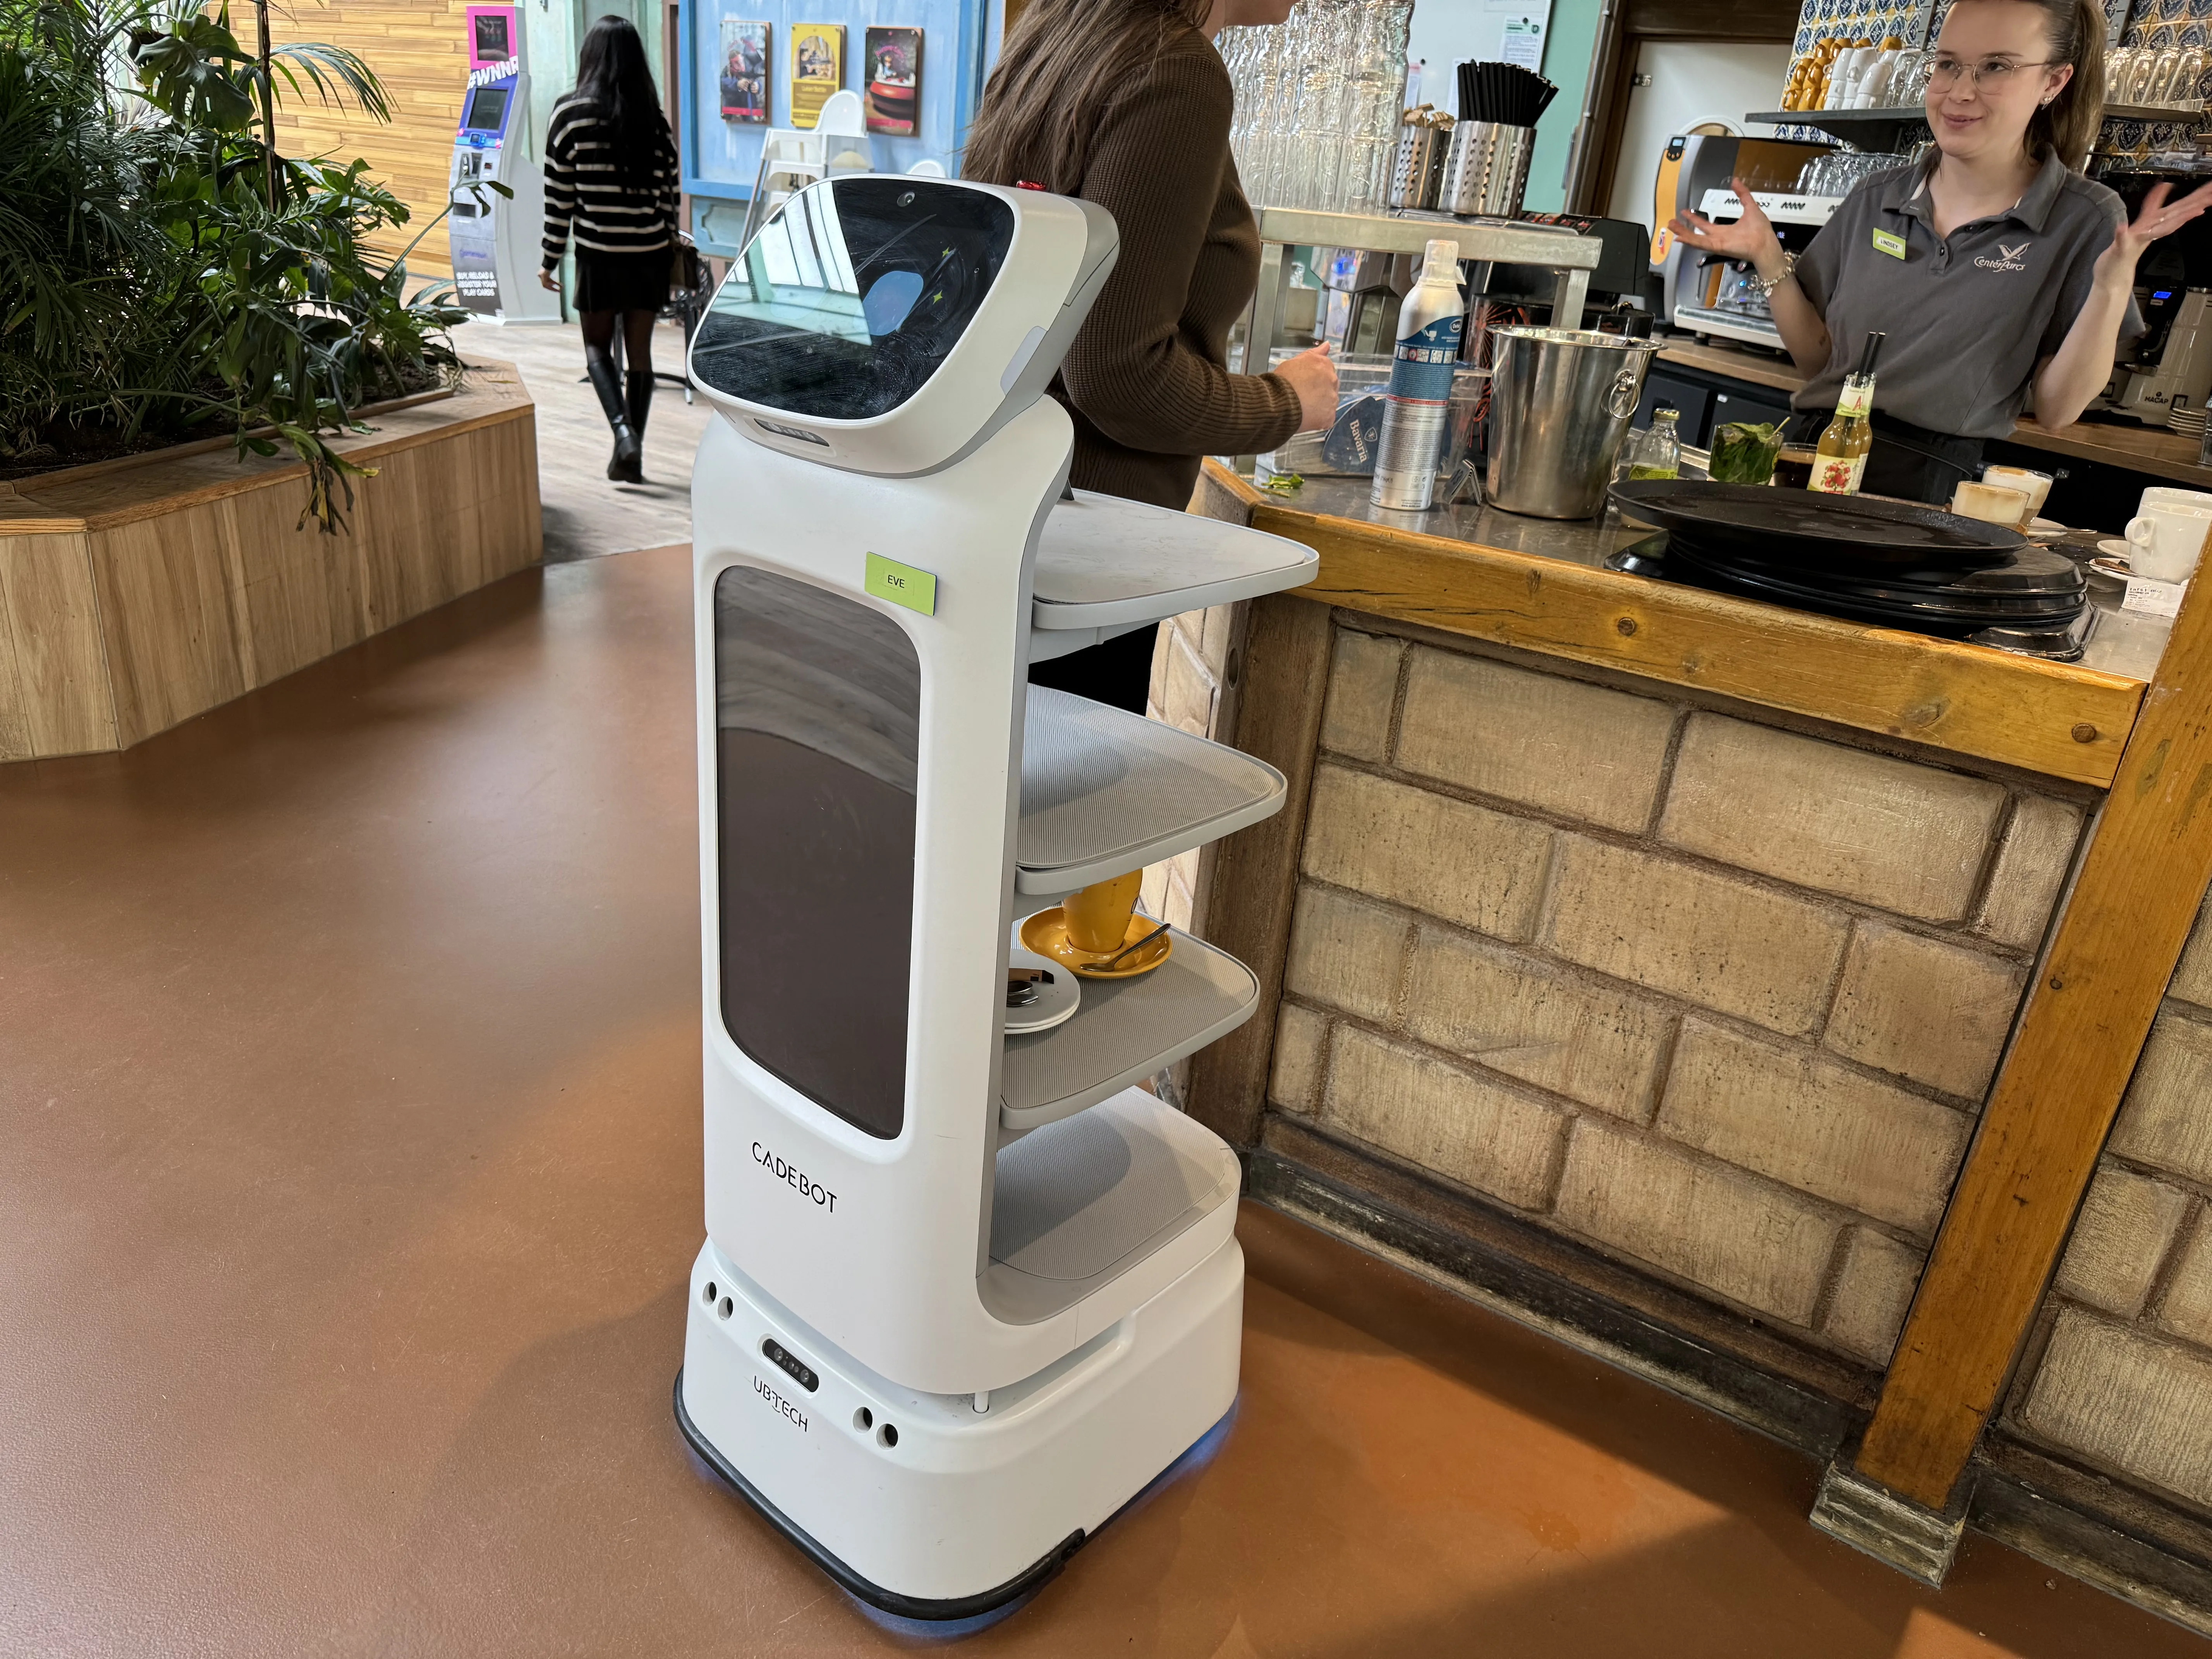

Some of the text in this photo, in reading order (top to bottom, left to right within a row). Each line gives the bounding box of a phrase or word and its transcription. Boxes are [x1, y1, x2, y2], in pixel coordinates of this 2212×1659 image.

[2144, 396, 2169, 404] MACAP
[1350, 418, 1367, 463] Bavaria
[888, 574, 905, 588] EVE
[752, 1142, 837, 1213] CADEBOT
[754, 1375, 808, 1432] UBTECH
